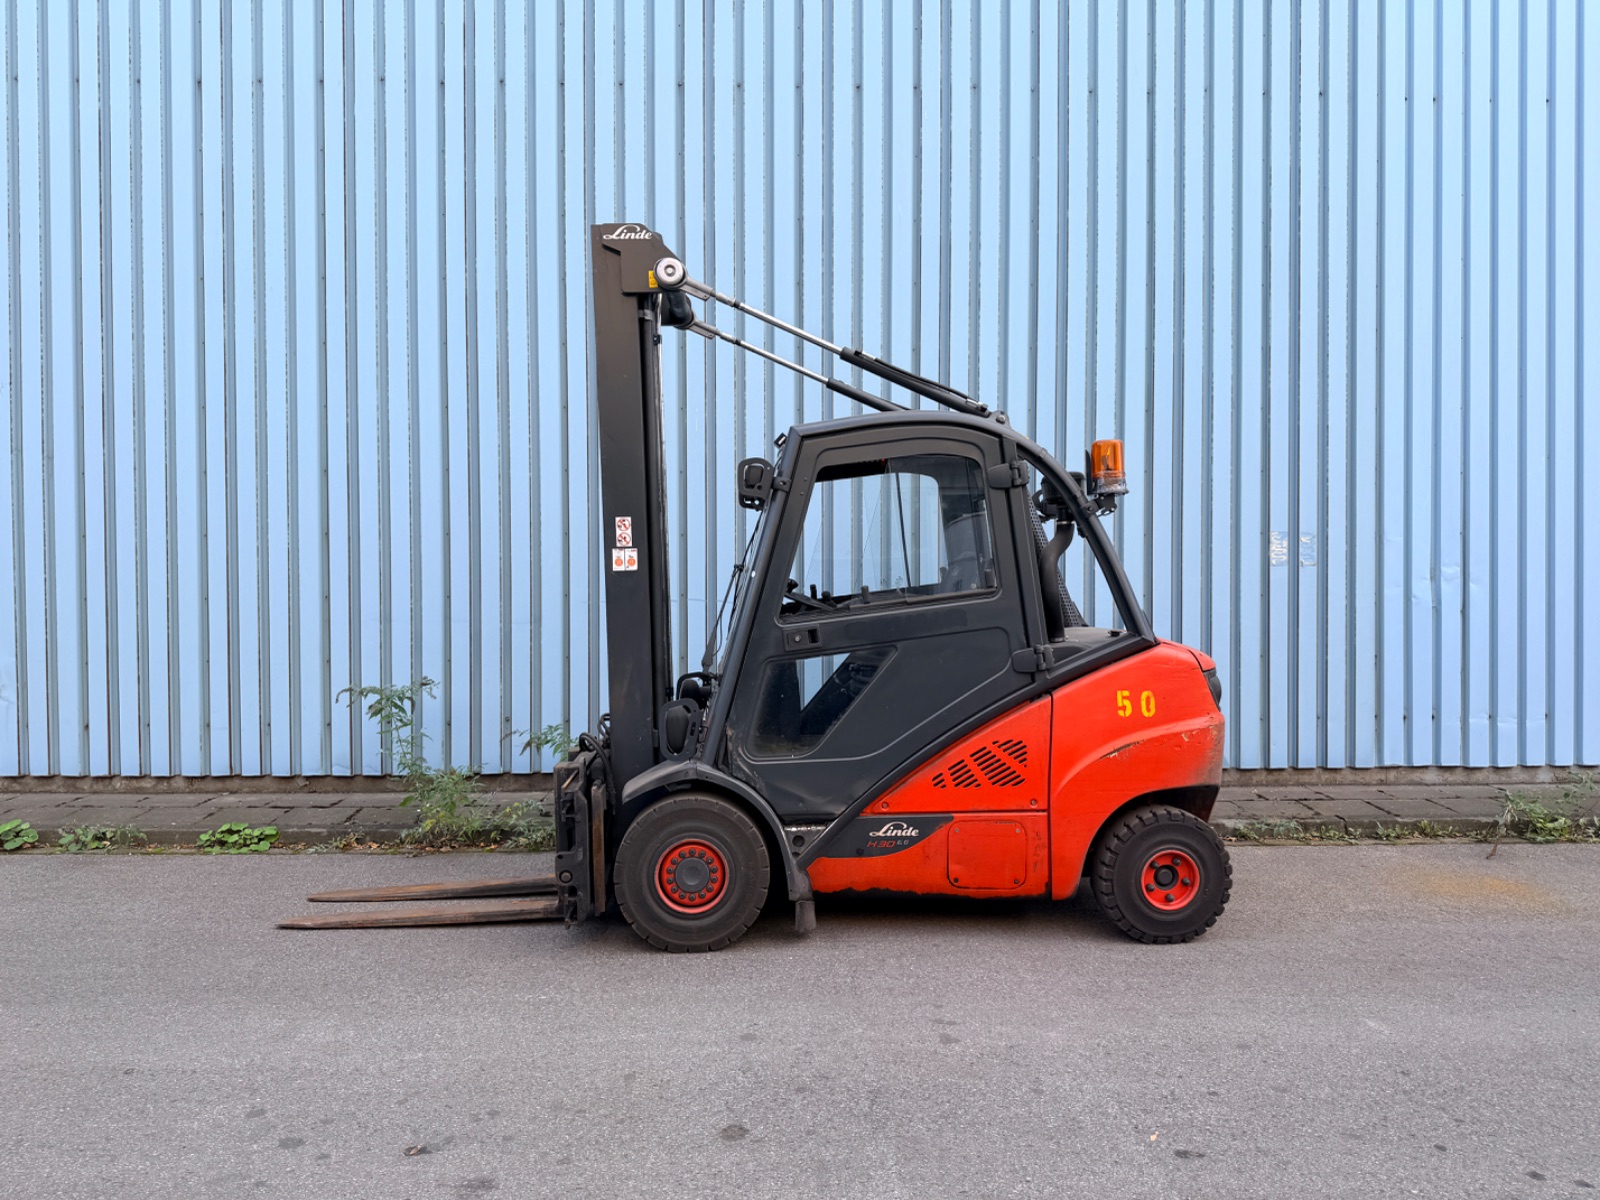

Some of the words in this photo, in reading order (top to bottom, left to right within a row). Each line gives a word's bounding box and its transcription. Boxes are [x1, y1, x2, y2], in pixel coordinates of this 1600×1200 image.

[603, 224, 652, 239] Linde
[1116, 690, 1156, 717] 50
[869, 821, 919, 837] Linde
